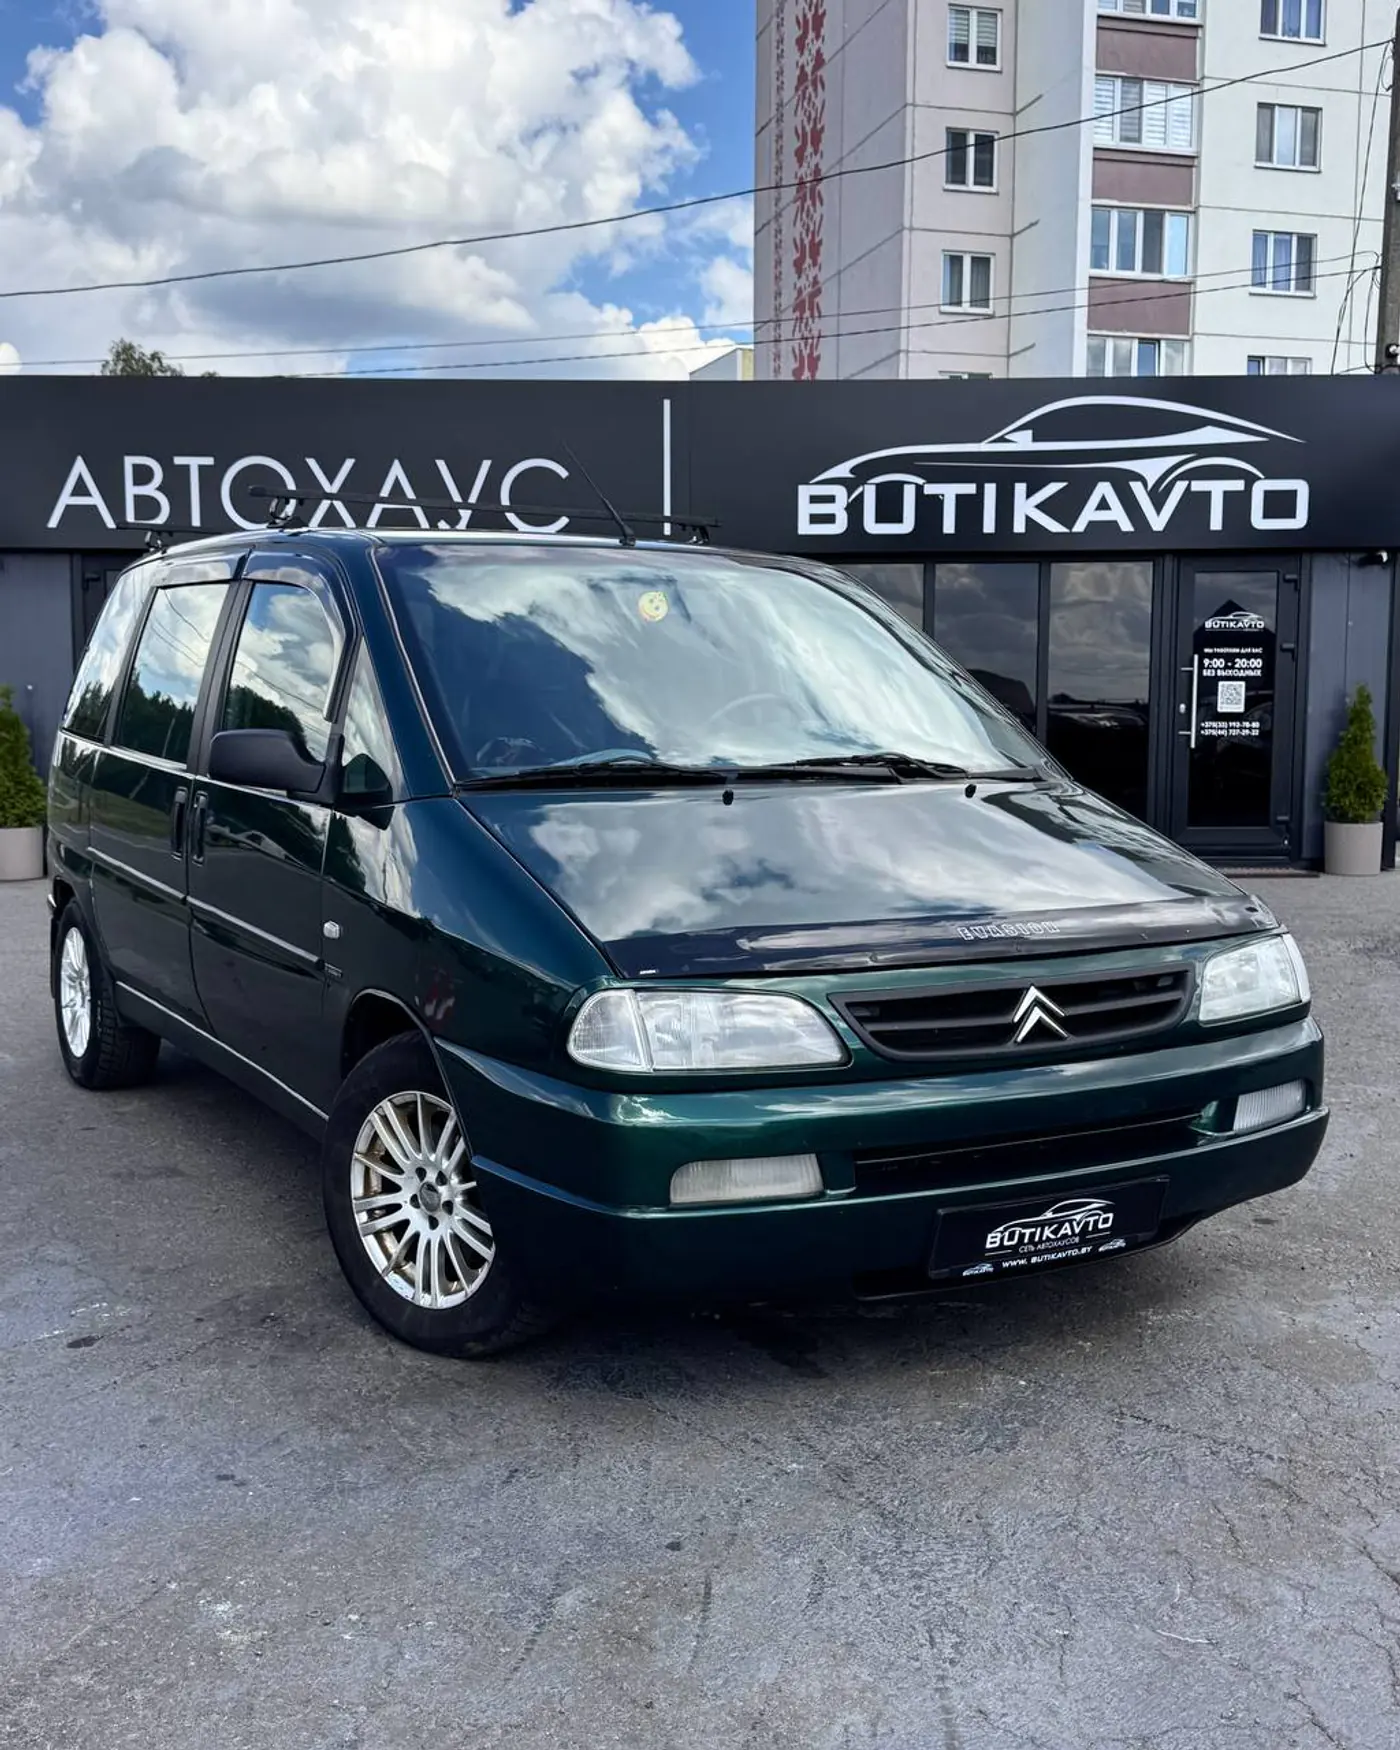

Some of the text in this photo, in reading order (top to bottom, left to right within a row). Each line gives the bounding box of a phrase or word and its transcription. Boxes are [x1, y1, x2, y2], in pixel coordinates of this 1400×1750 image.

[47, 455, 570, 533] АВТОХАУС
[797, 478, 1309, 535] BUTIKAVTO
[1204, 620, 1265, 629] BUTIKAVTO
[1203, 658, 1225, 668] 9:00
[1234, 658, 1263, 668] 20:00
[957, 921, 1060, 940] EVASION
[985, 1212, 1114, 1248] BUTIKAVTO
